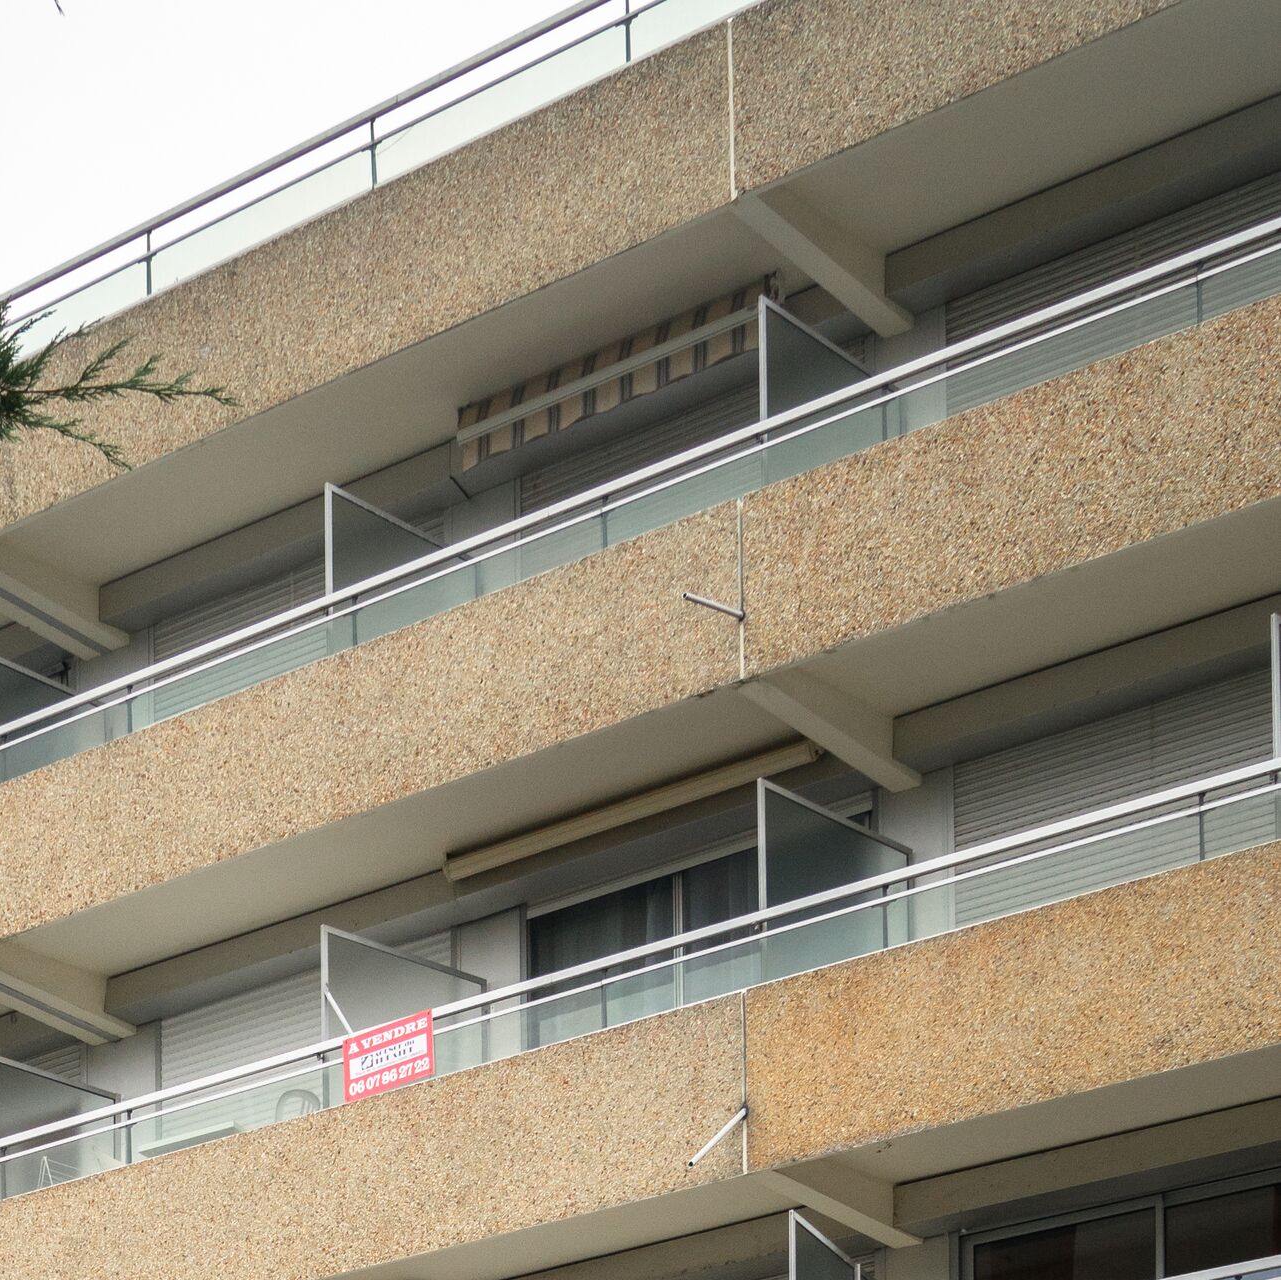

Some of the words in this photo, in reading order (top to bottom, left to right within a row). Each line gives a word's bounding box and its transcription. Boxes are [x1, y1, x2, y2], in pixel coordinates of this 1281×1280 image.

[348, 1042, 360, 1055] A
[361, 1018, 427, 1049] VENDRE
[366, 1074, 380, 1090] 07
[399, 1062, 413, 1079] 27
[414, 1057, 430, 1073] 22
